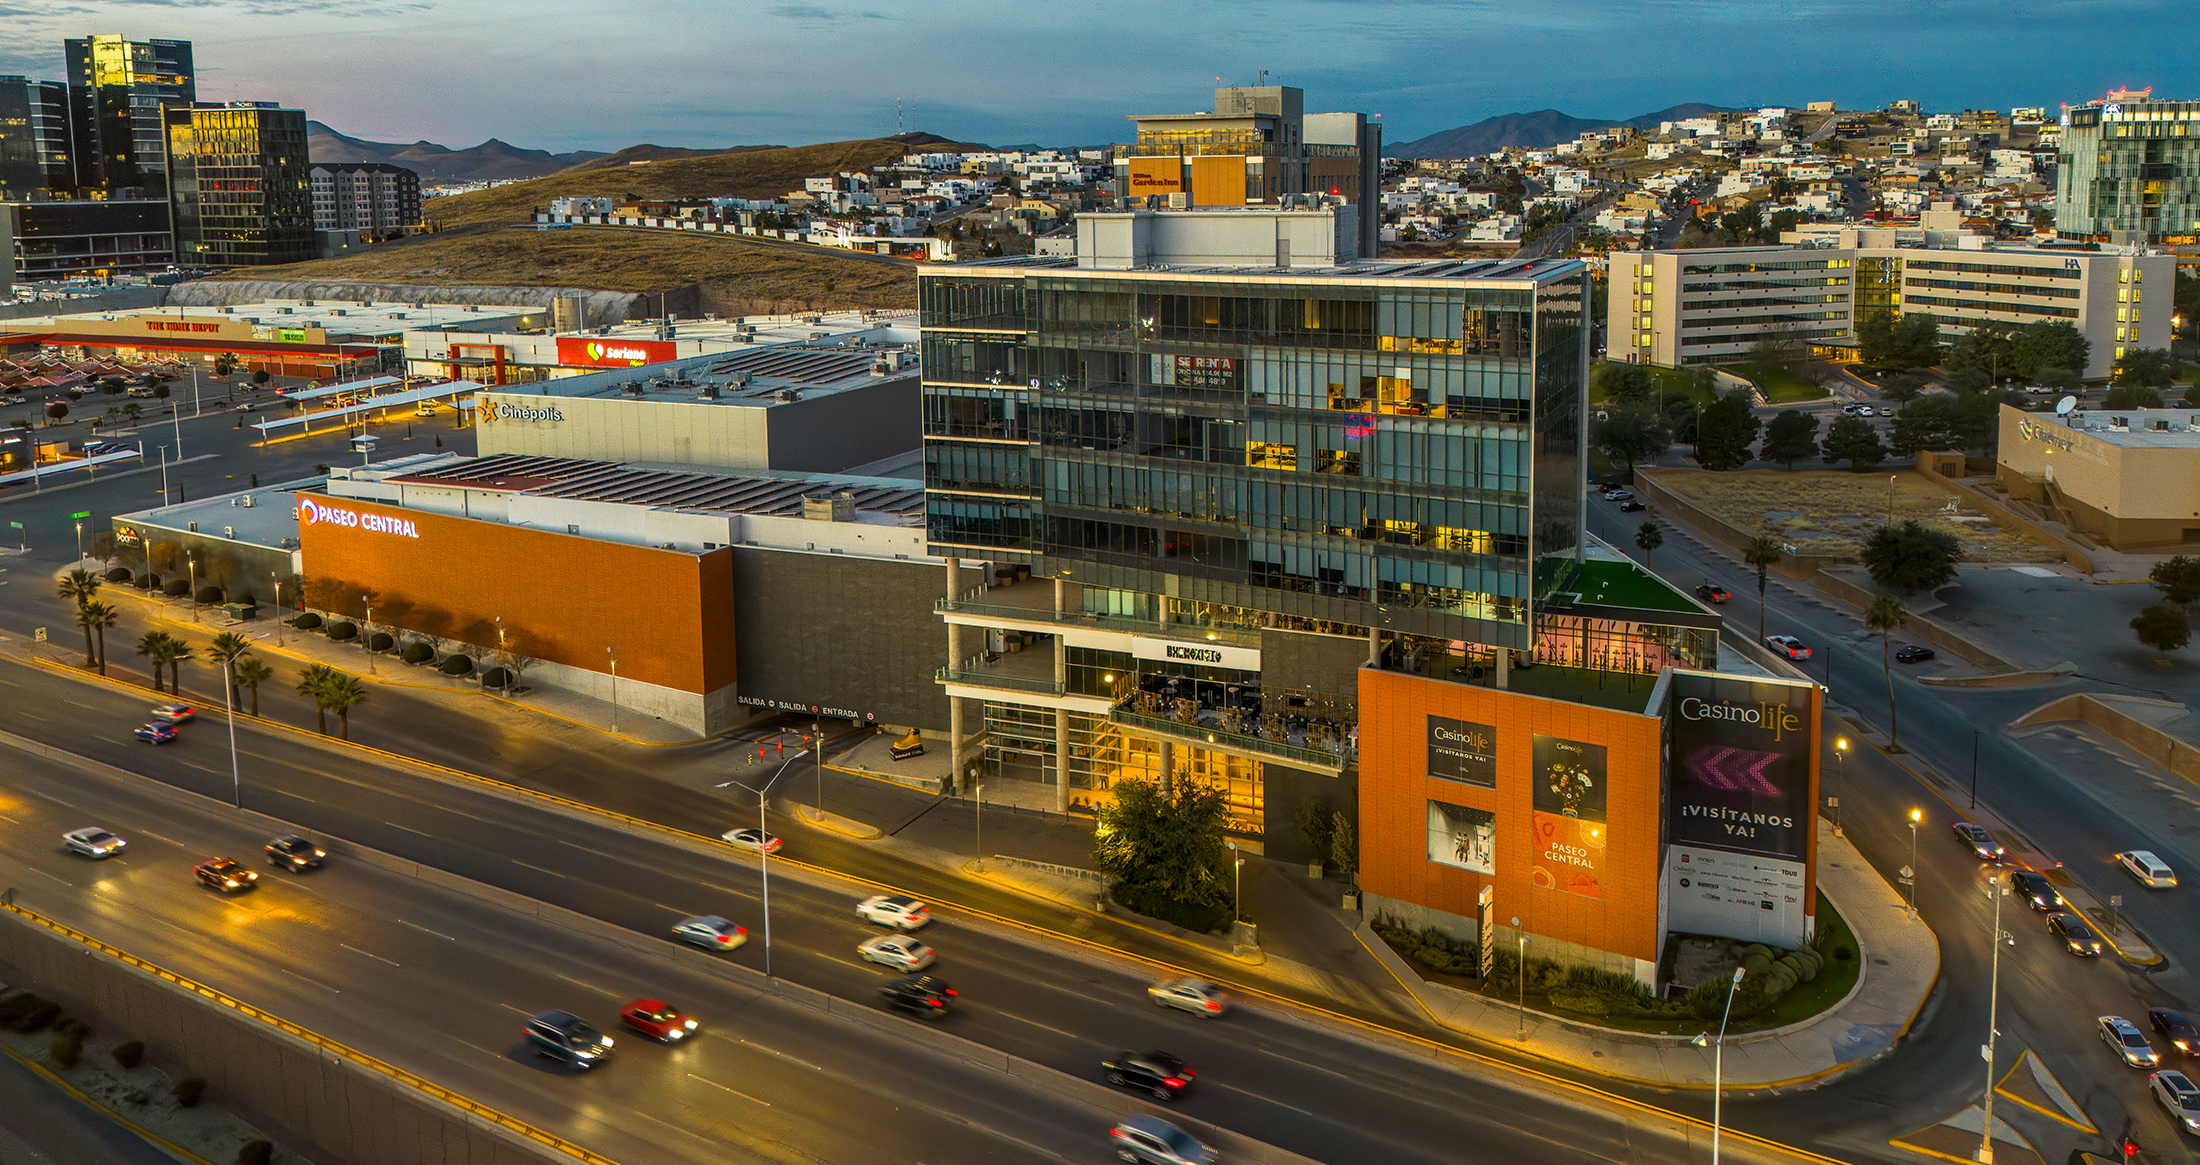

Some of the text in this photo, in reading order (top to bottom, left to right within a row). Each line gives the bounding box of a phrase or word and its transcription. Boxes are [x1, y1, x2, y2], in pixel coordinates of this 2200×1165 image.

[146, 321, 219, 333] THE HOME DEPOT
[606, 346, 646, 361] Soriana
[1178, 356, 1231, 369] SE RENTA
[319, 505, 420, 539] PASEO CENTRAL
[738, 696, 766, 707] SALIDA
[779, 701, 807, 712] SALIDA
[822, 707, 859, 719] ENTRADA
[1682, 804, 1793, 828] ¡VISÍTANOS
[1724, 823, 1755, 838] YA!
[1552, 842, 1587, 858] PASEO
[1544, 851, 1594, 870] CENTRAL
[1781, 869, 1798, 877] TOUS
